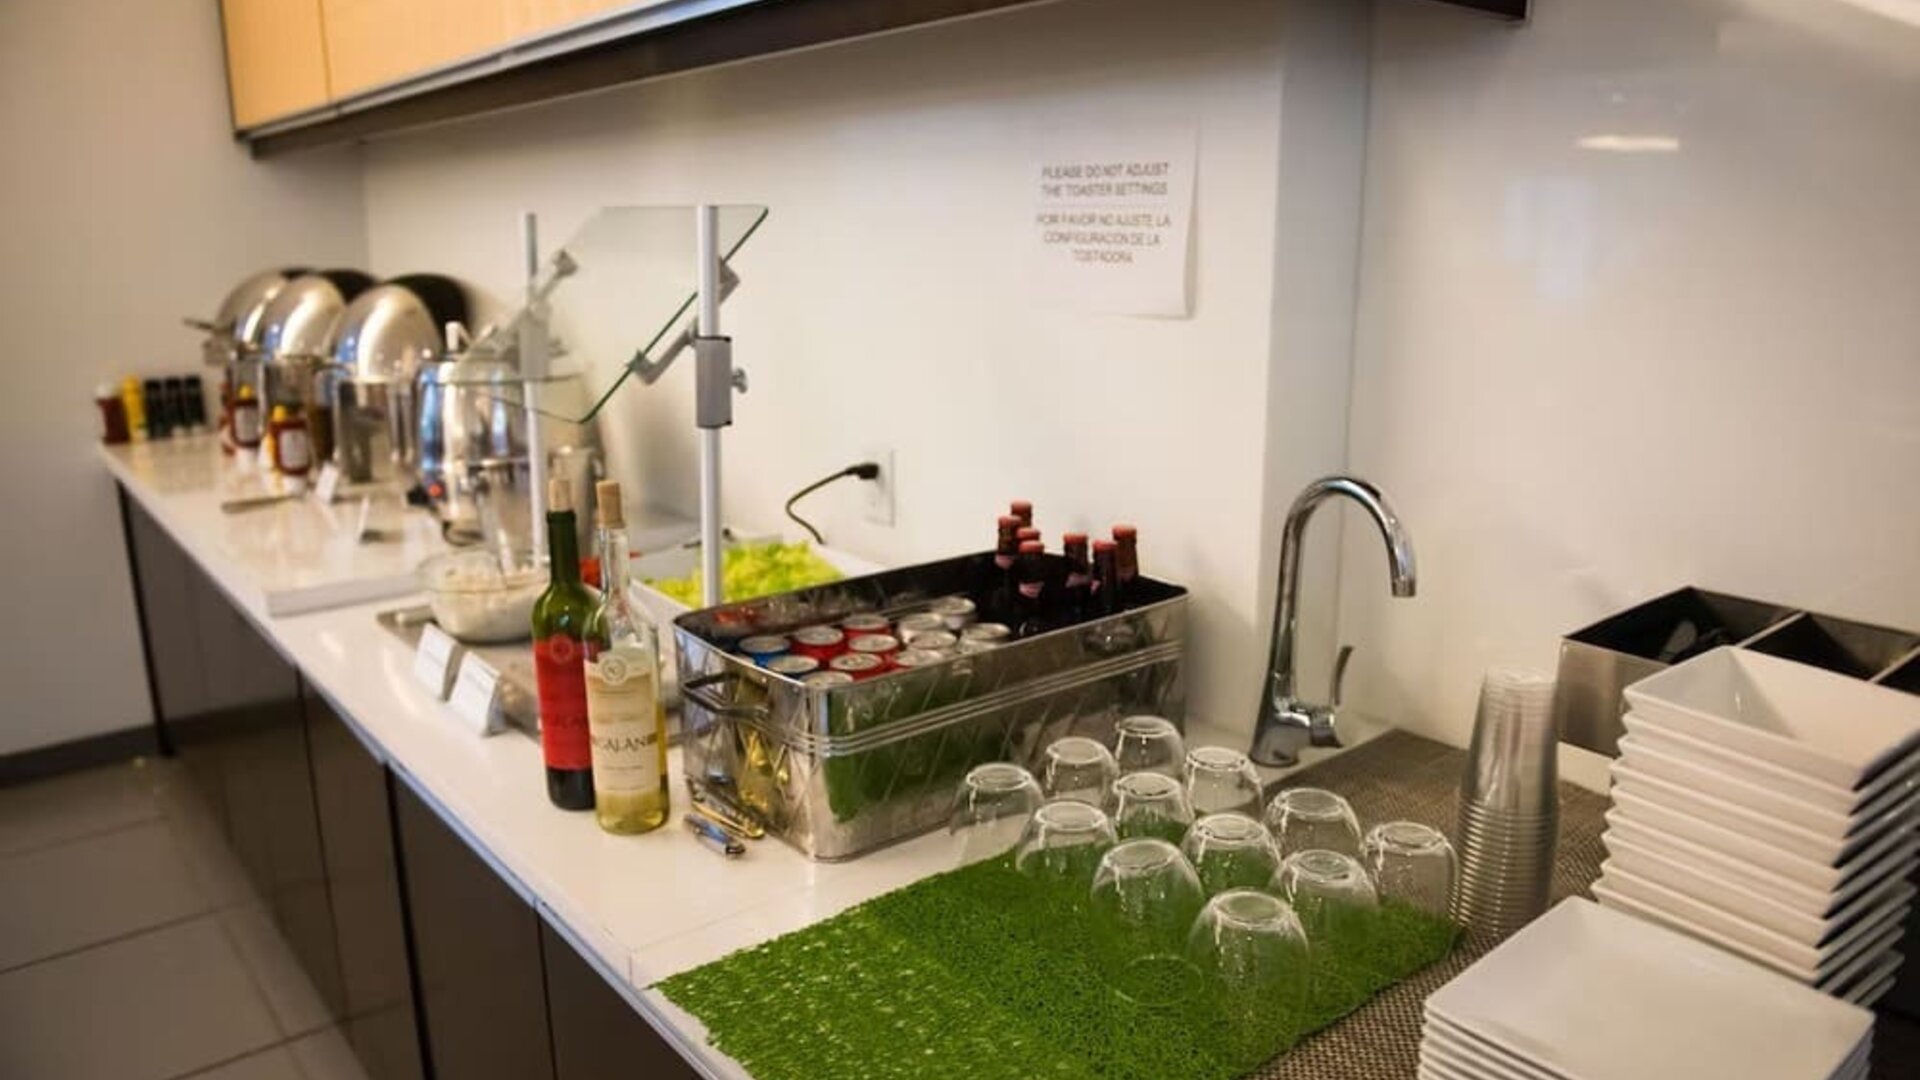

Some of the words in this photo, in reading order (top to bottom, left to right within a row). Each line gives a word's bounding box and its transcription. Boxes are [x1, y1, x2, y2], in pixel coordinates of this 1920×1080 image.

[1041, 164, 1083, 179] PLEASE
[1085, 164, 1101, 178] DO
[1103, 162, 1124, 177] NOT
[1126, 161, 1169, 176] ADJUST
[1041, 183, 1061, 197] THE
[1065, 182, 1112, 197] TOASTER
[1115, 181, 1169, 196] SETTINGS
[1061, 213, 1096, 226] FAVOR
[1156, 214, 1172, 228] LA
